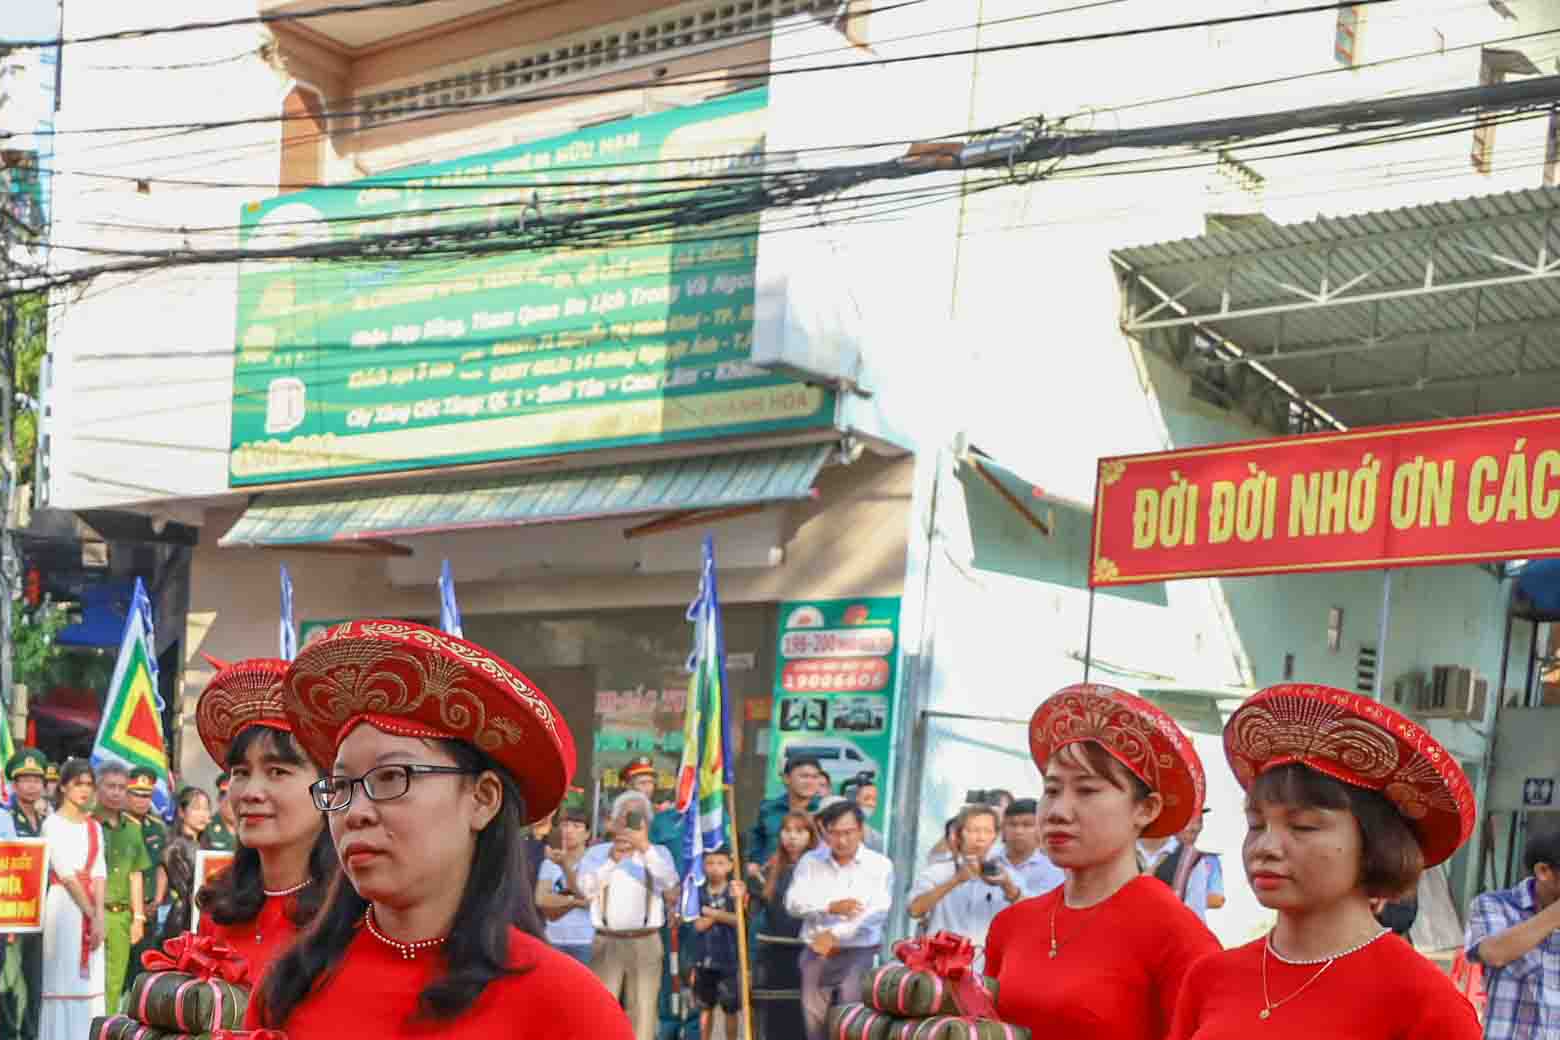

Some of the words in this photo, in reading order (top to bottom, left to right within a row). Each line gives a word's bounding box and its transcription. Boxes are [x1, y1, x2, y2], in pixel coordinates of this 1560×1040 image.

[1132, 469, 1200, 549] ĐỜI
[1207, 461, 1279, 544] ĐỜI
[1287, 451, 1382, 538] NHỚ
[1390, 454, 1456, 531] ƠN
[1467, 436, 1560, 525] CÁC
